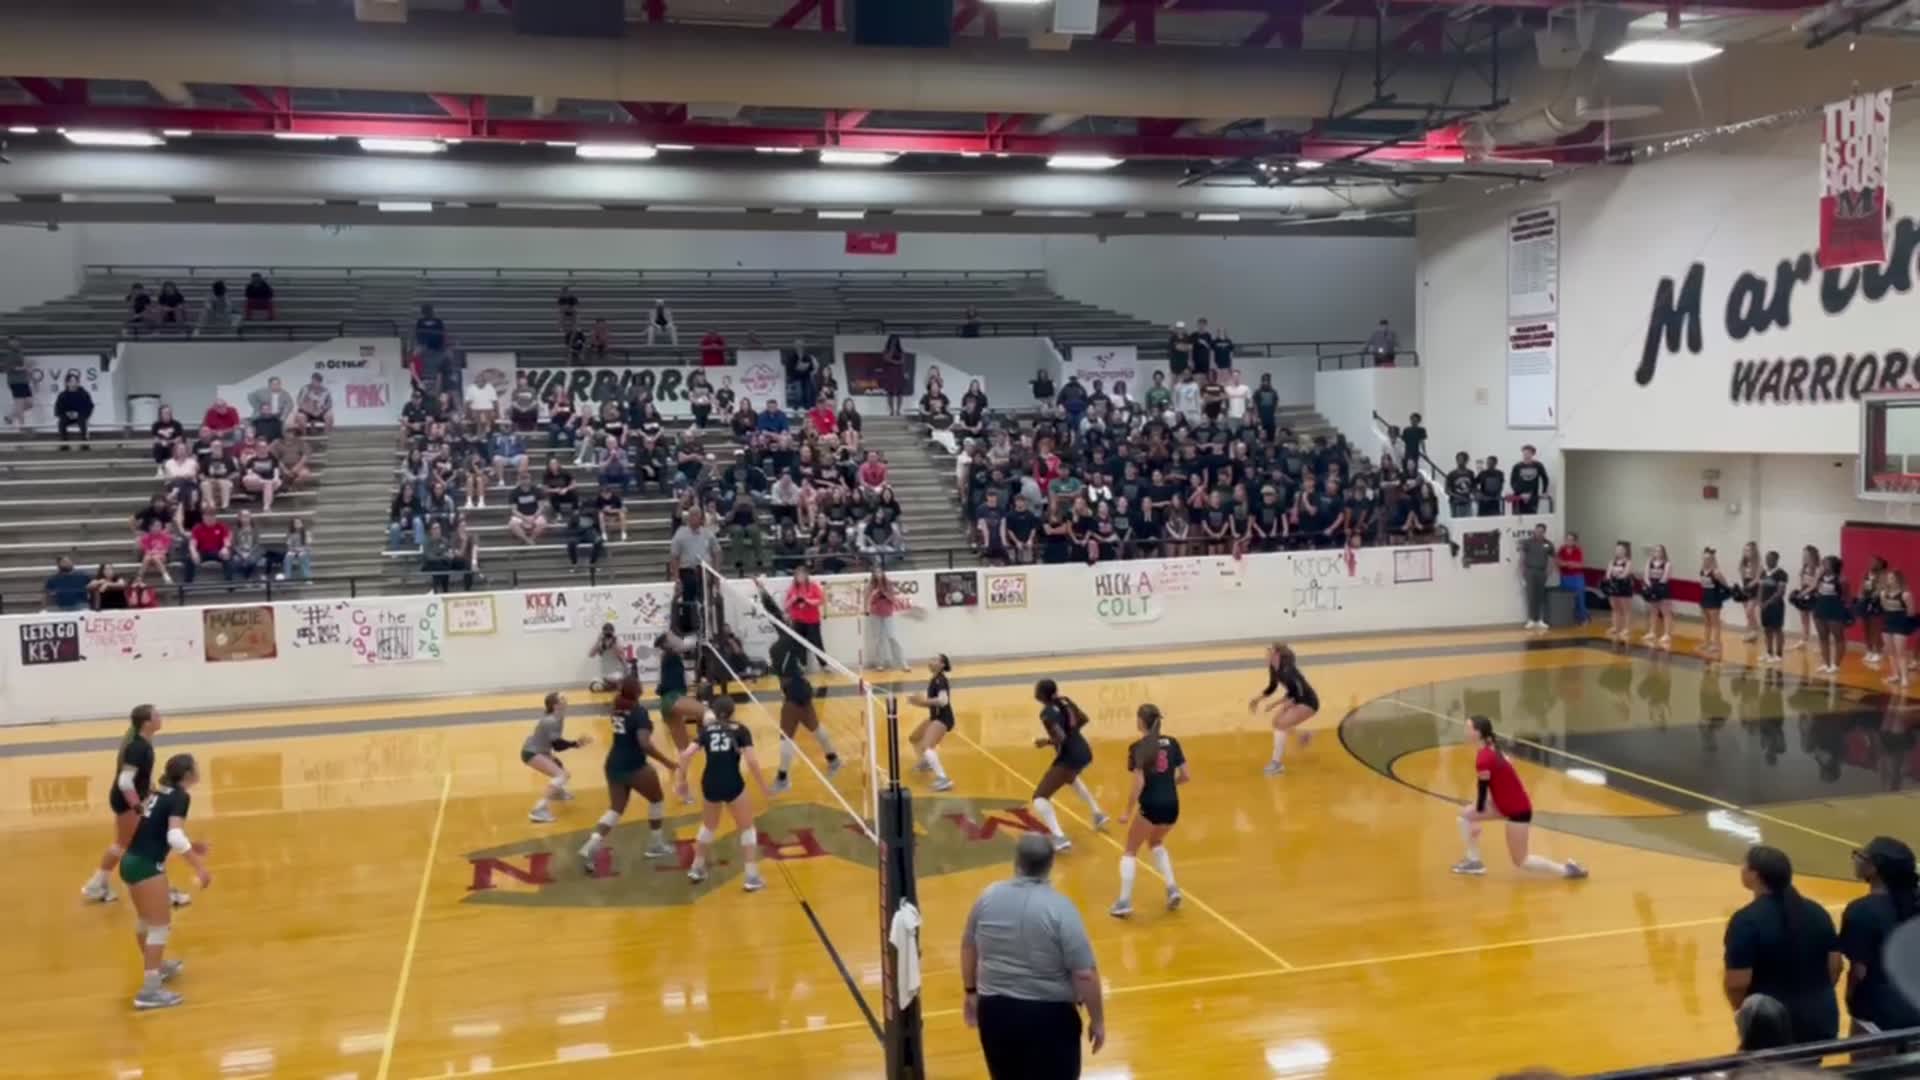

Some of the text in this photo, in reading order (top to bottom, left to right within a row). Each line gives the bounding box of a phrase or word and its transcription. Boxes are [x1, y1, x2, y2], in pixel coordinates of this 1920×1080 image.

[1822, 87, 1892, 146] THIS
[1730, 349, 1920, 405] WARRIOR
[1137, 570, 1153, 593] A
[556, 592, 567, 608] A
[1096, 594, 1151, 617] COLT
[378, 612, 407, 625] the
[28, 641, 61, 662] KEY
[709, 732, 731, 751] 23
[466, 803, 1052, 892] MRTIN
